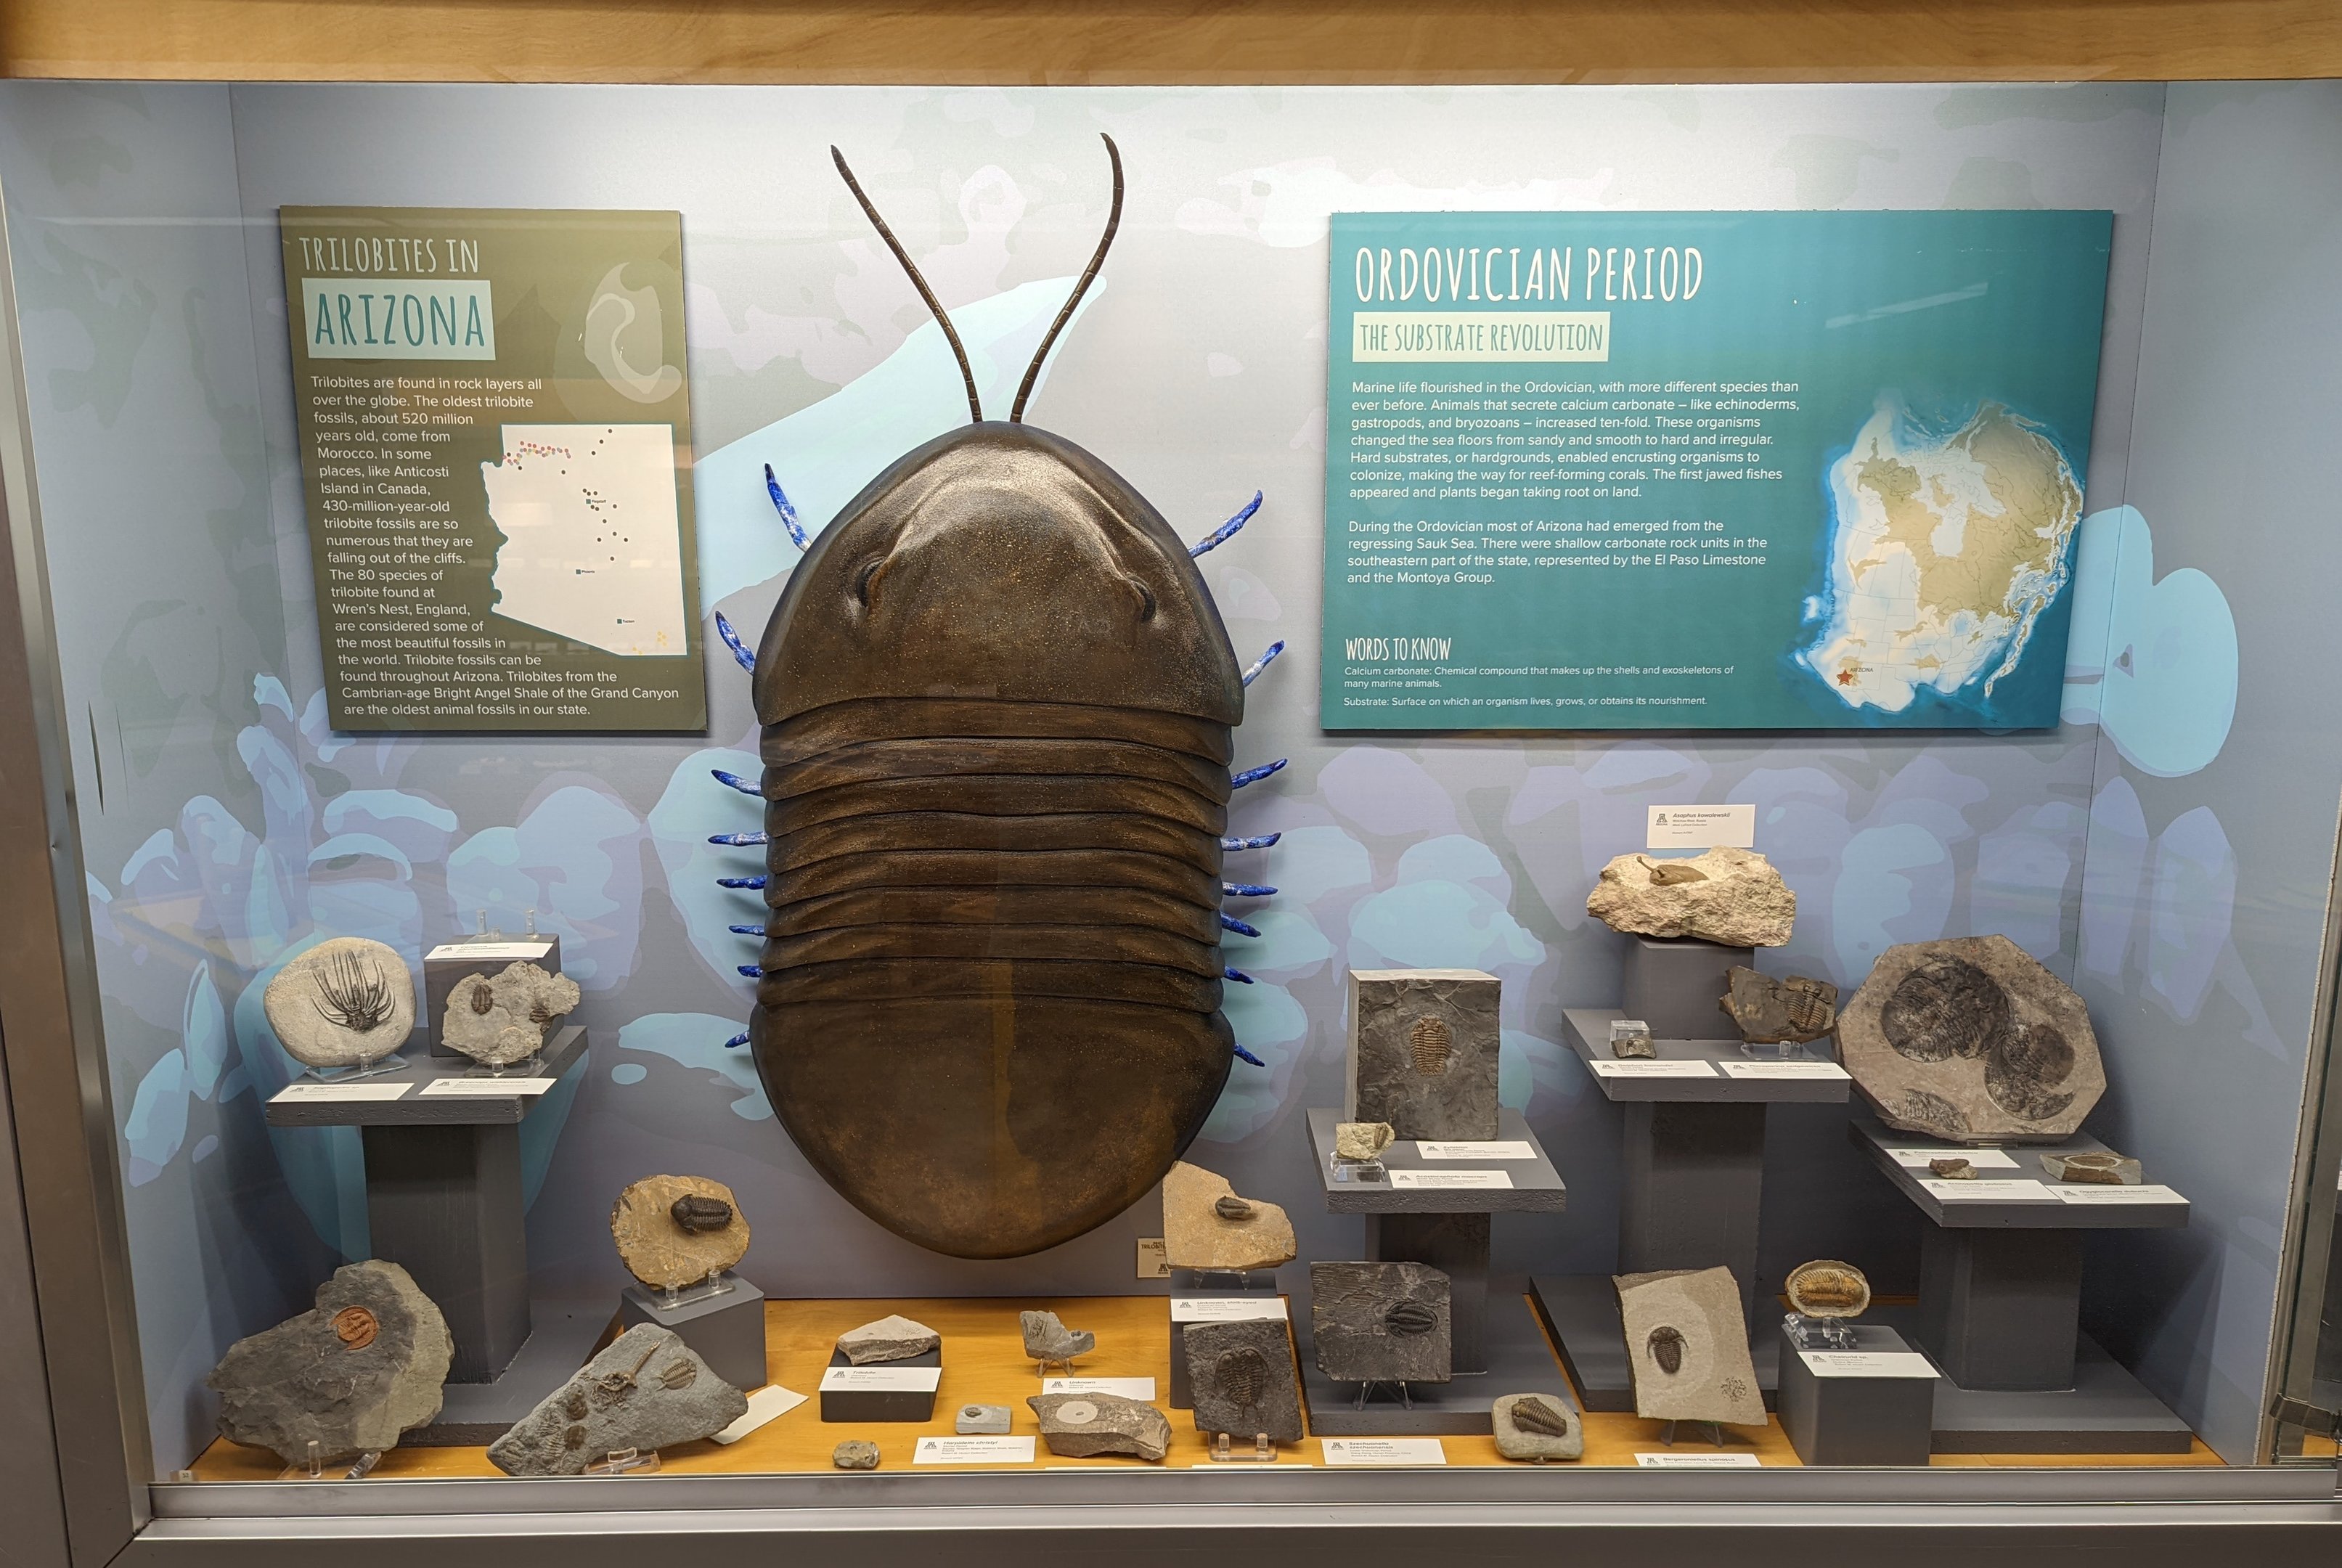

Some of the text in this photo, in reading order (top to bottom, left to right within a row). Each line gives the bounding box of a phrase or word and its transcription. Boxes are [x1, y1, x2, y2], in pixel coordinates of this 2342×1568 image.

[299, 237, 478, 273] TRILOBITES IN
[1355, 246, 1702, 302] ORDOVICIAN PERIOD
[314, 293, 484, 346] ARIZONA
[1360, 324, 1603, 351] THE SUBSTRATE REVOLUTION
[310, 376, 542, 392] Trilobites are found in rock layers all
[1352, 380, 1798, 394] Marine life flourished in the Ordovician, with more different species than
[313, 394, 534, 409] over the globe. The oldest trilobite
[314, 412, 473, 425] fossils, about 520 million
[315, 430, 450, 444] years old, come from
[1351, 433, 1773, 448] changed the sea floors from sandy and smooth to hard and irregular.
[317, 447, 431, 460] Morocco. In some
[319, 465, 449, 478] places, like Anticosti
[322, 499, 449, 514] 430-million-year-old
[326, 535, 473, 549] numerous that they are
[1348, 536, 1767, 552] regressing Sauk Sea. There were shallow carbonate rock units in the
[329, 569, 443, 583] The 80 species of
[330, 586, 435, 597] trilobite found at
[359, 621, 430, 632] considered
[433, 623, 468, 632] some
[471, 621, 484, 632] of
[1345, 637, 1451, 661] WORDS TO KNOW
[340, 670, 617, 684] found throughout Arizona. Trilobites from the
[1345, 666, 1381, 675] Calcium
[1434, 666, 1477, 675] Chemical
[1479, 666, 1528, 676] compound
[1596, 666, 1612, 674] the
[1614, 666, 1640, 674] shells
[1642, 666, 1660, 674] and
[1723, 665, 1734, 674] of
[1371, 679, 1403, 687] marine
[1405, 679, 1442, 687] animals.
[342, 687, 679, 701] Cambrian-age Bright Angel Shale of the Grand Canyon
[1344, 697, 1389, 706] Substrate:
[1392, 697, 1427, 706] Surface
[1443, 697, 1469, 706] which
[1485, 697, 1527, 707] organism
[1530, 697, 1553, 706] lives,
[1555, 698, 1586, 707] grows,
[1636, 696, 1647, 705] its
[1649, 696, 1707, 705] nourishment.
